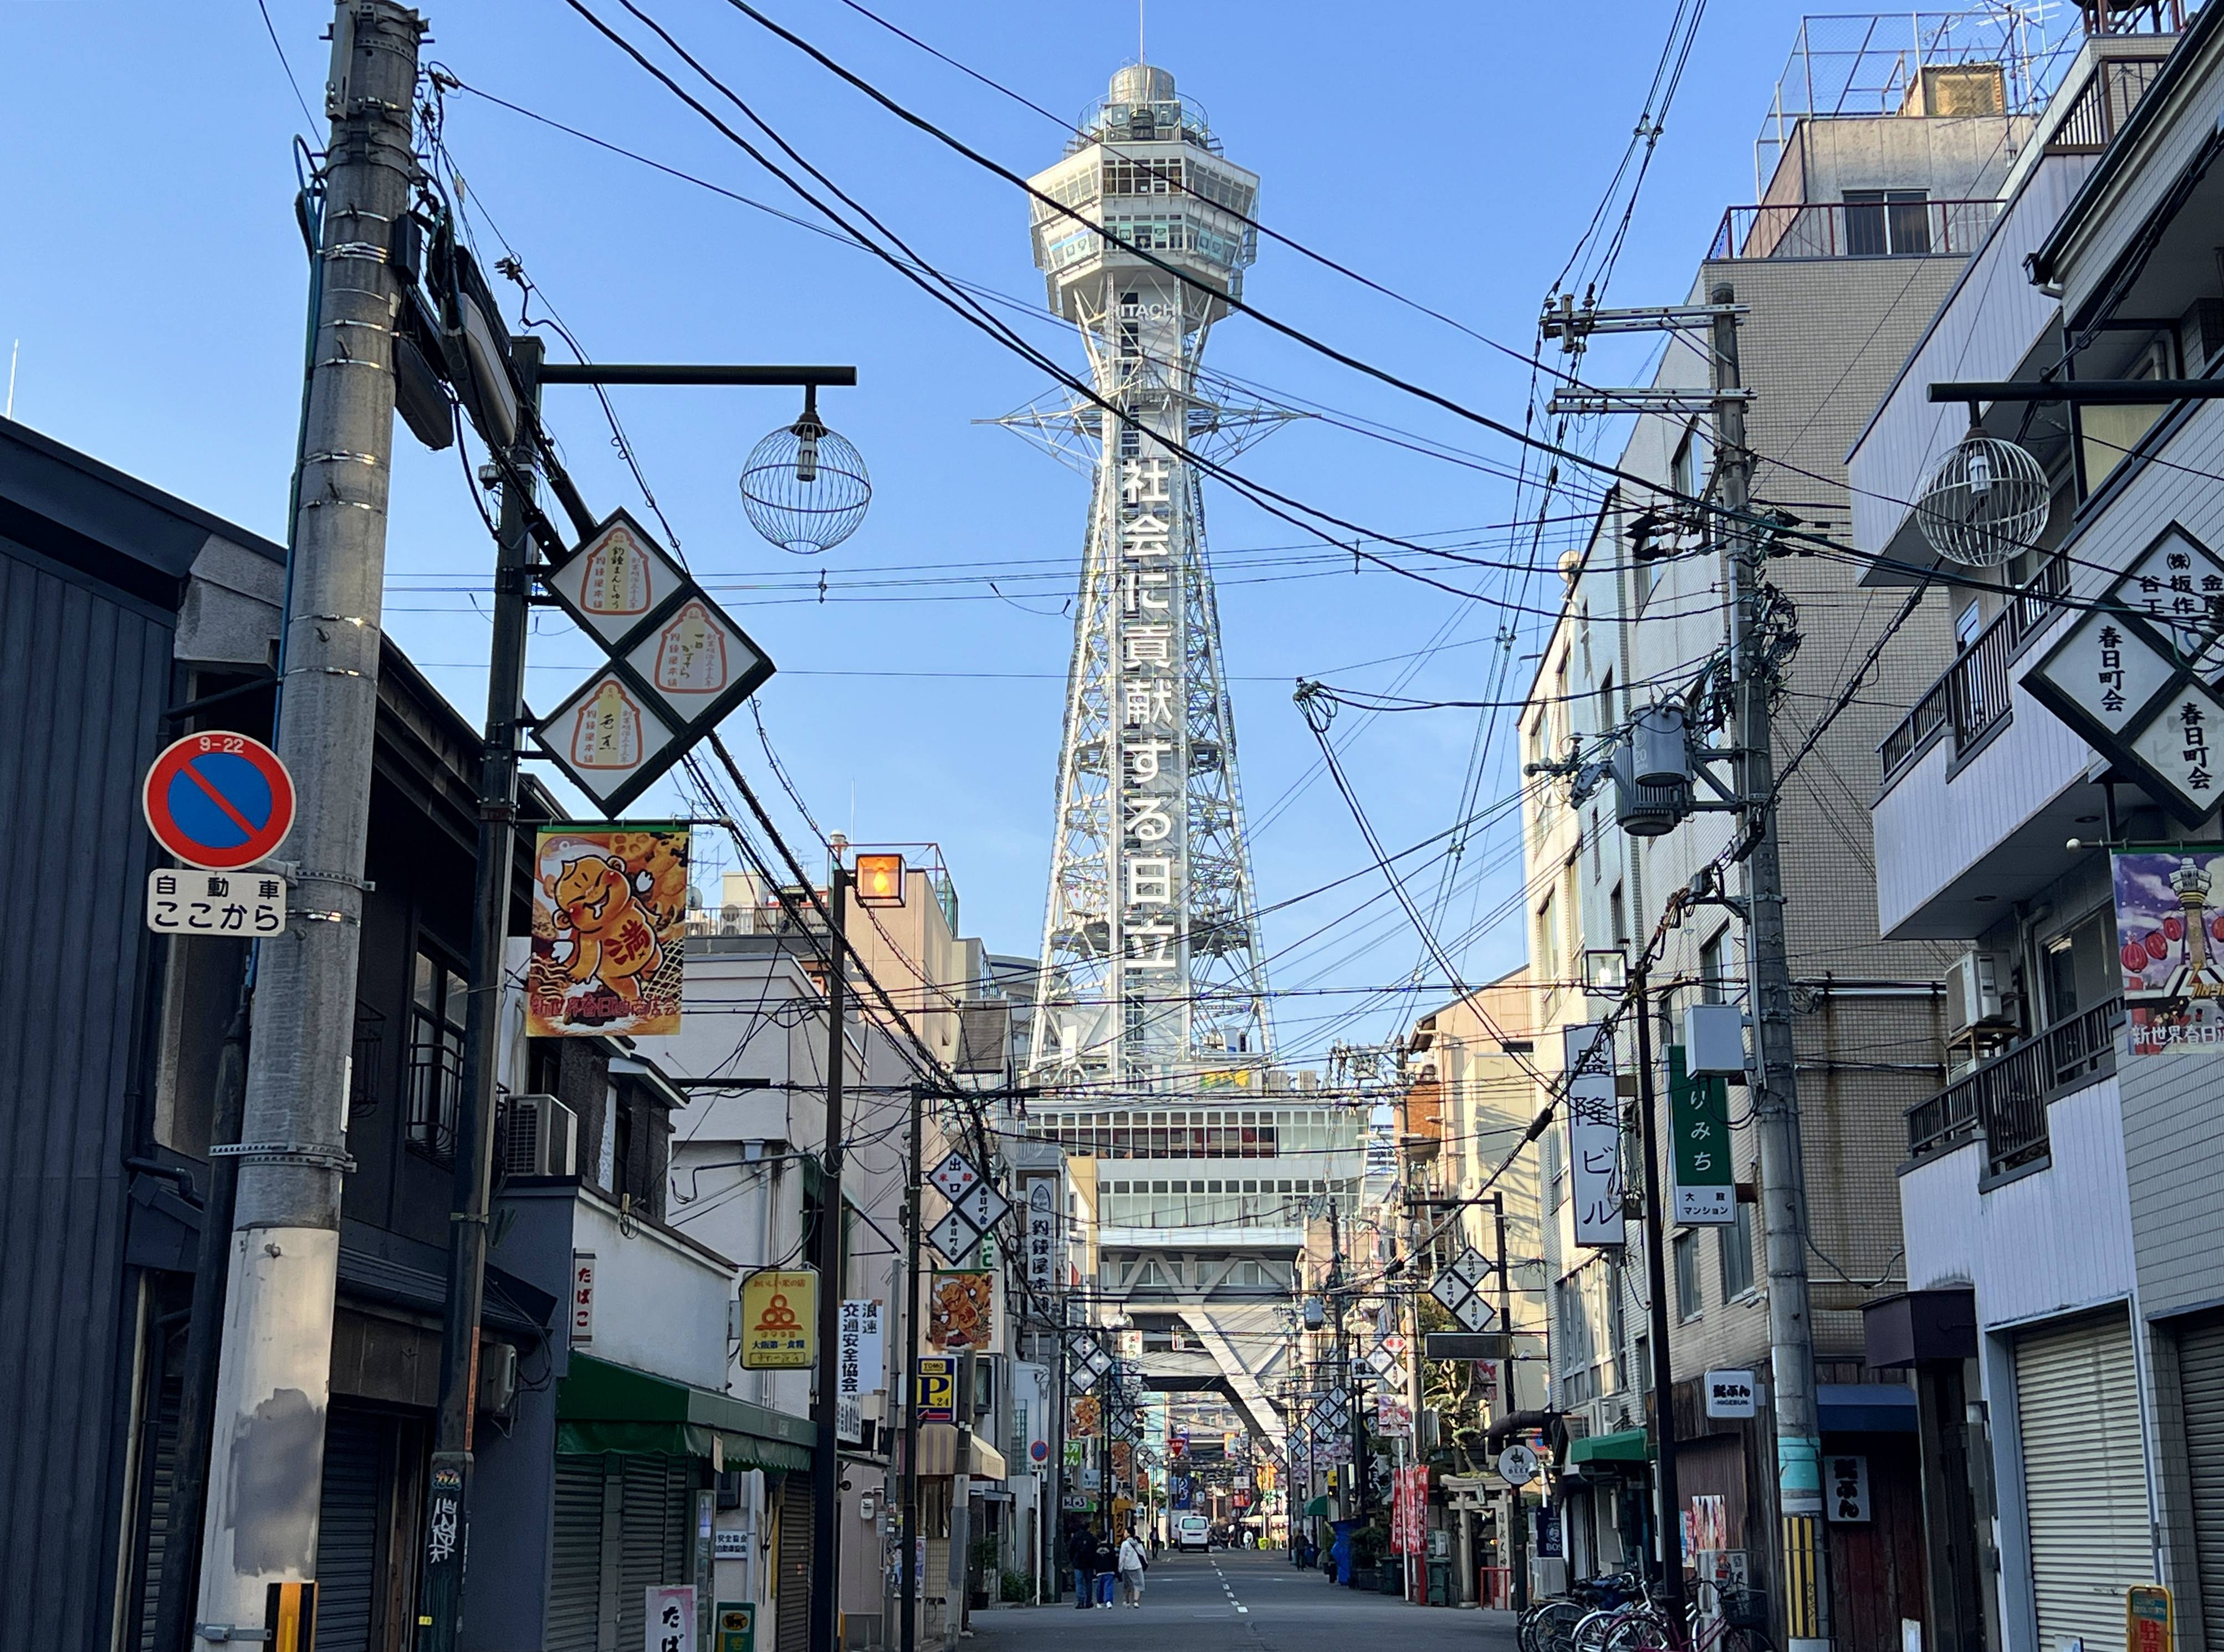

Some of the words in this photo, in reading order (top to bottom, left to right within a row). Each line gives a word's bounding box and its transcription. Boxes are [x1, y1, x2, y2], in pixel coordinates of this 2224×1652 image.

[1106, 303, 1182, 317] HITACHI
[611, 546, 625, 609] 釣鐘まんじゅう
[2139, 574, 2223, 593] 谷板金
[2098, 625, 2126, 712] 春日町会
[1122, 459, 1175, 968] 社会に貢献する日立
[199, 737, 244, 754] 9-22
[2180, 702, 2213, 790] 春日町会
[156, 876, 280, 900] 自動車
[154, 902, 279, 932] ここから
[604, 919, 651, 966] 満
[1574, 1049, 1618, 1226] 盛隆ビル
[978, 1187, 988, 1225] 春日町会
[1684, 1206, 1727, 1215] マンション
[948, 1217, 958, 1256] 春日町会
[577, 1267, 591, 1327] たばこ
[842, 1303, 859, 1393] 交通安全協会
[918, 1377, 949, 1406] P
[662, 1605, 684, 1652] たば
